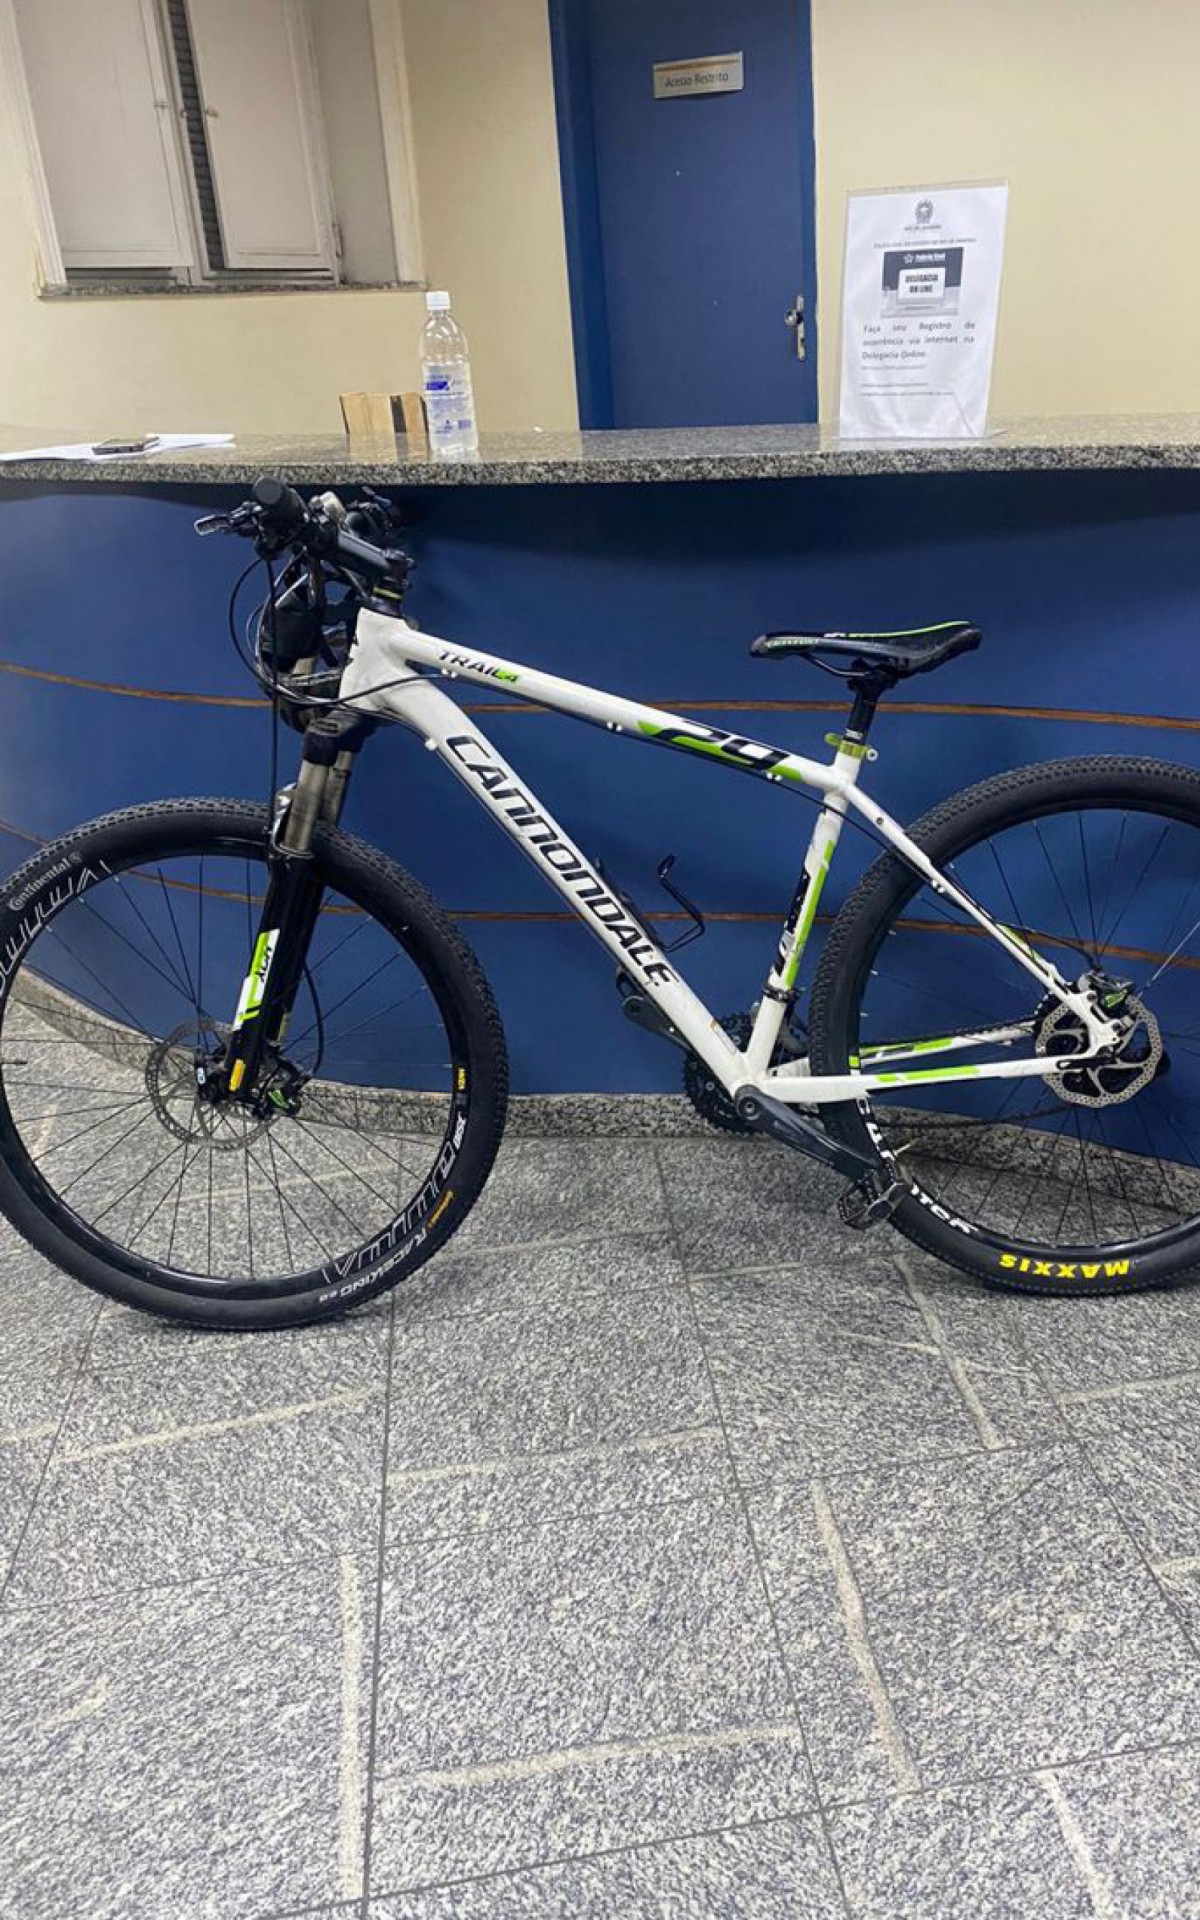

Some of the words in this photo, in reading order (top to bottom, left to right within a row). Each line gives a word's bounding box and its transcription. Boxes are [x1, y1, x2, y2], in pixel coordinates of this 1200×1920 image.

[651, 717, 791, 771] 29
[8, 857, 72, 912] Continental
[998, 1253, 1131, 1280] MAXXIS
